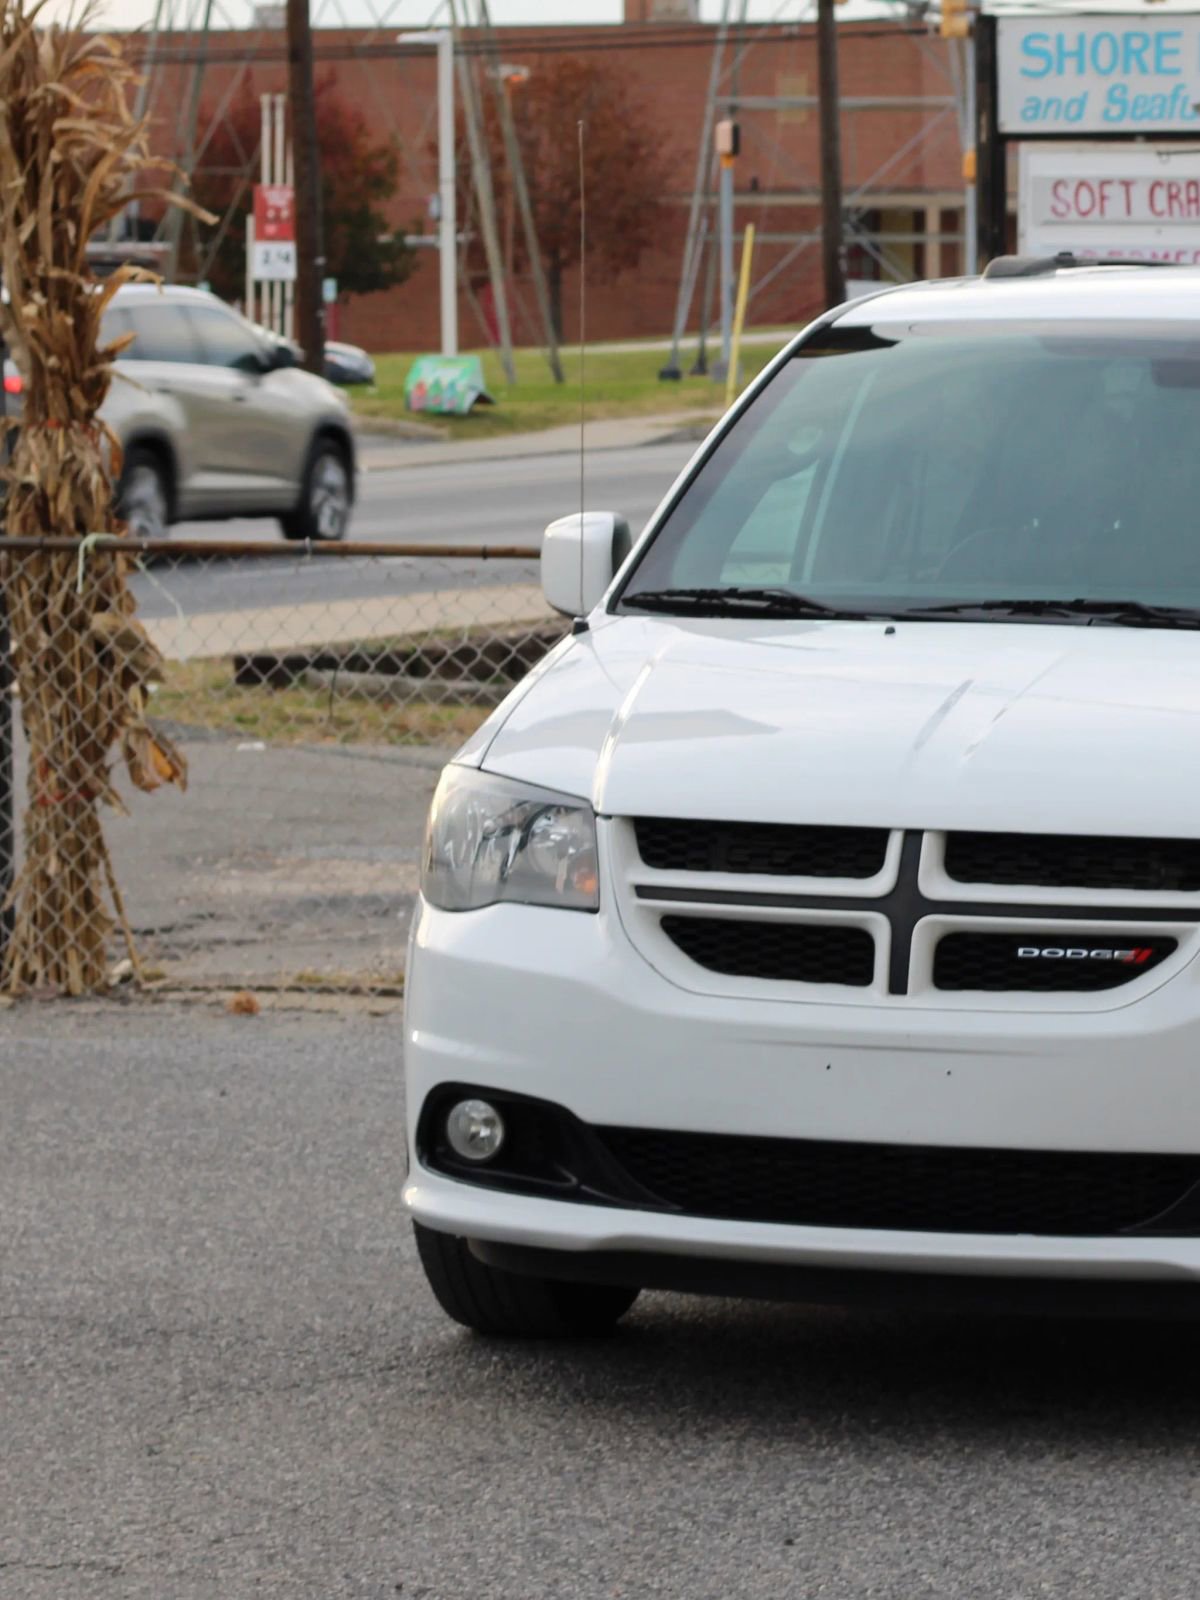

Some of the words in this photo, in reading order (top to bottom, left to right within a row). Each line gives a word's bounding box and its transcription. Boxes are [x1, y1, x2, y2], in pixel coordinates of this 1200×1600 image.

[1019, 30, 1183, 79] SHORE
[1020, 91, 1088, 122] and
[1050, 179, 1135, 219] SOFT
[1017, 947, 1136, 961] DODGE
